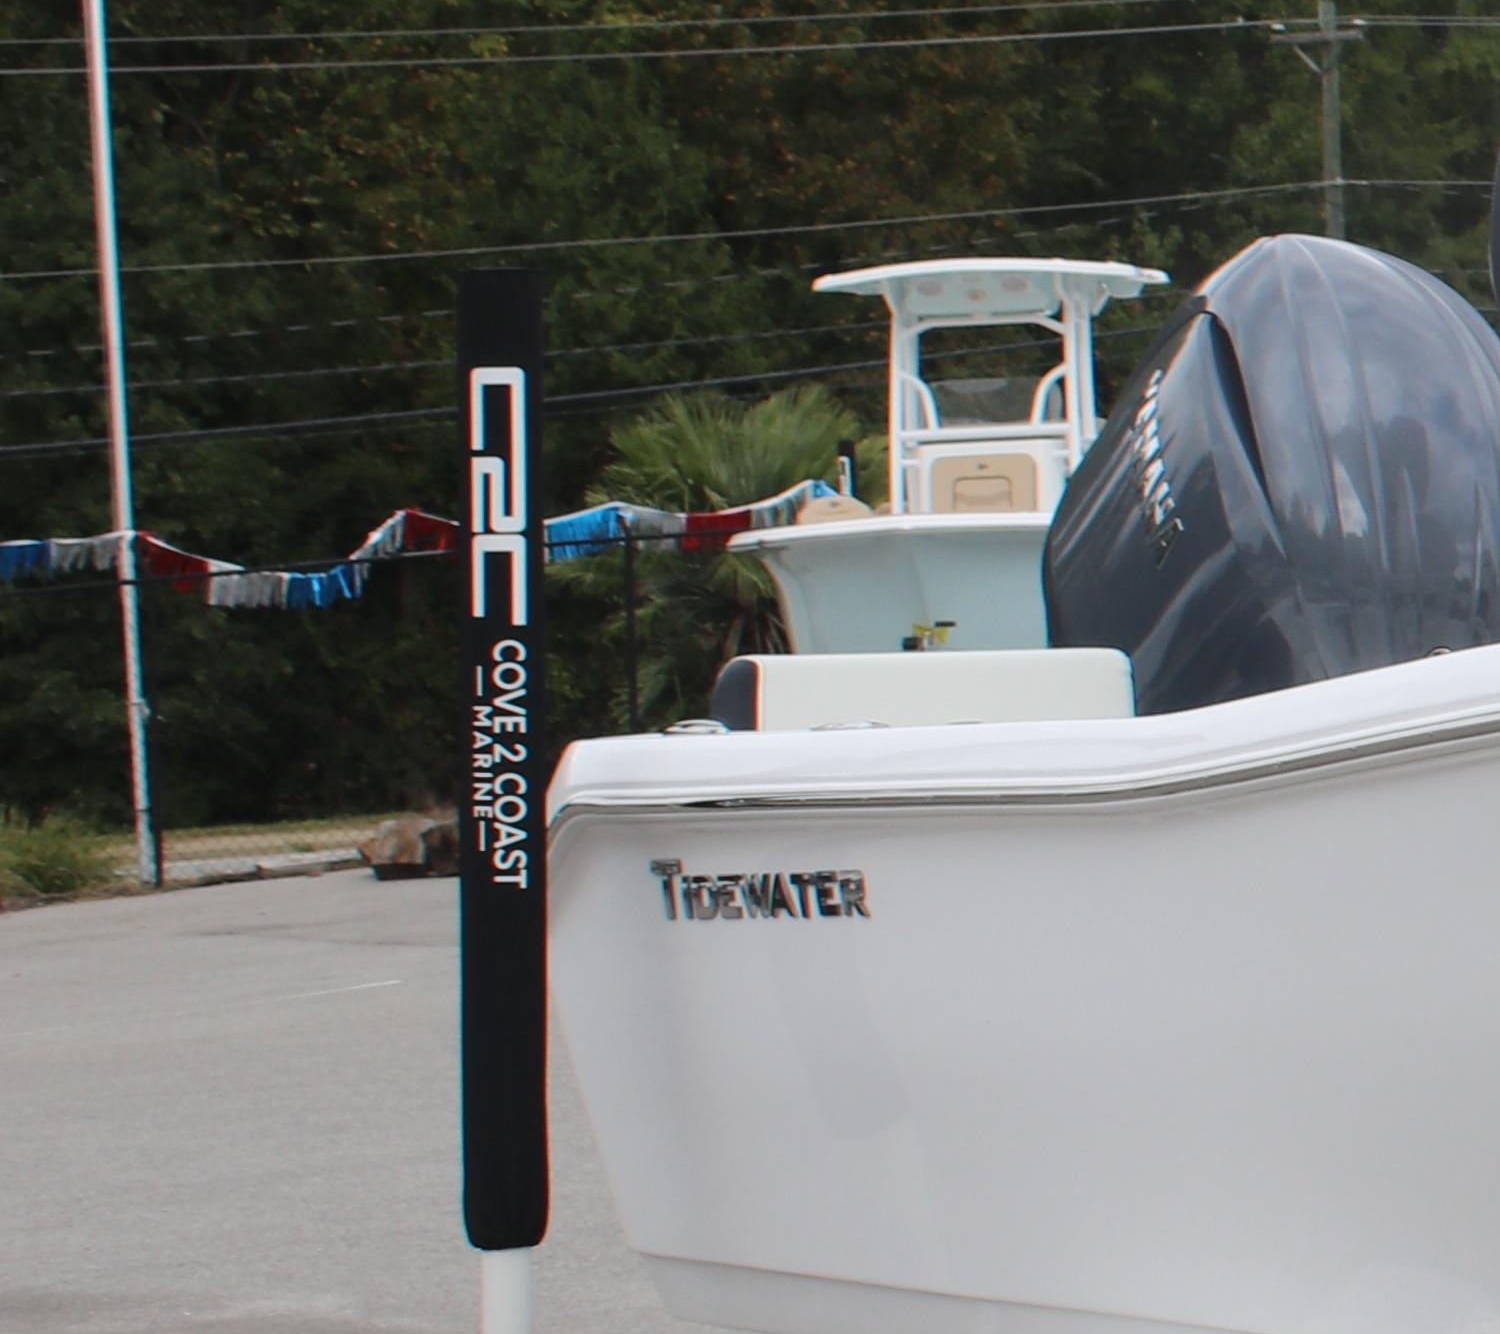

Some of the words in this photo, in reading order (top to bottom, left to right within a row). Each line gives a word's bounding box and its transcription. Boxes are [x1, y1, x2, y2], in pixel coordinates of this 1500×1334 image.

[470, 366, 528, 627] C2C
[492, 639, 528, 734] COVE
[471, 705, 494, 819] MARINE
[493, 743, 528, 764] 2
[493, 772, 528, 889] COAST
[650, 858, 871, 920] TIDEWATER
